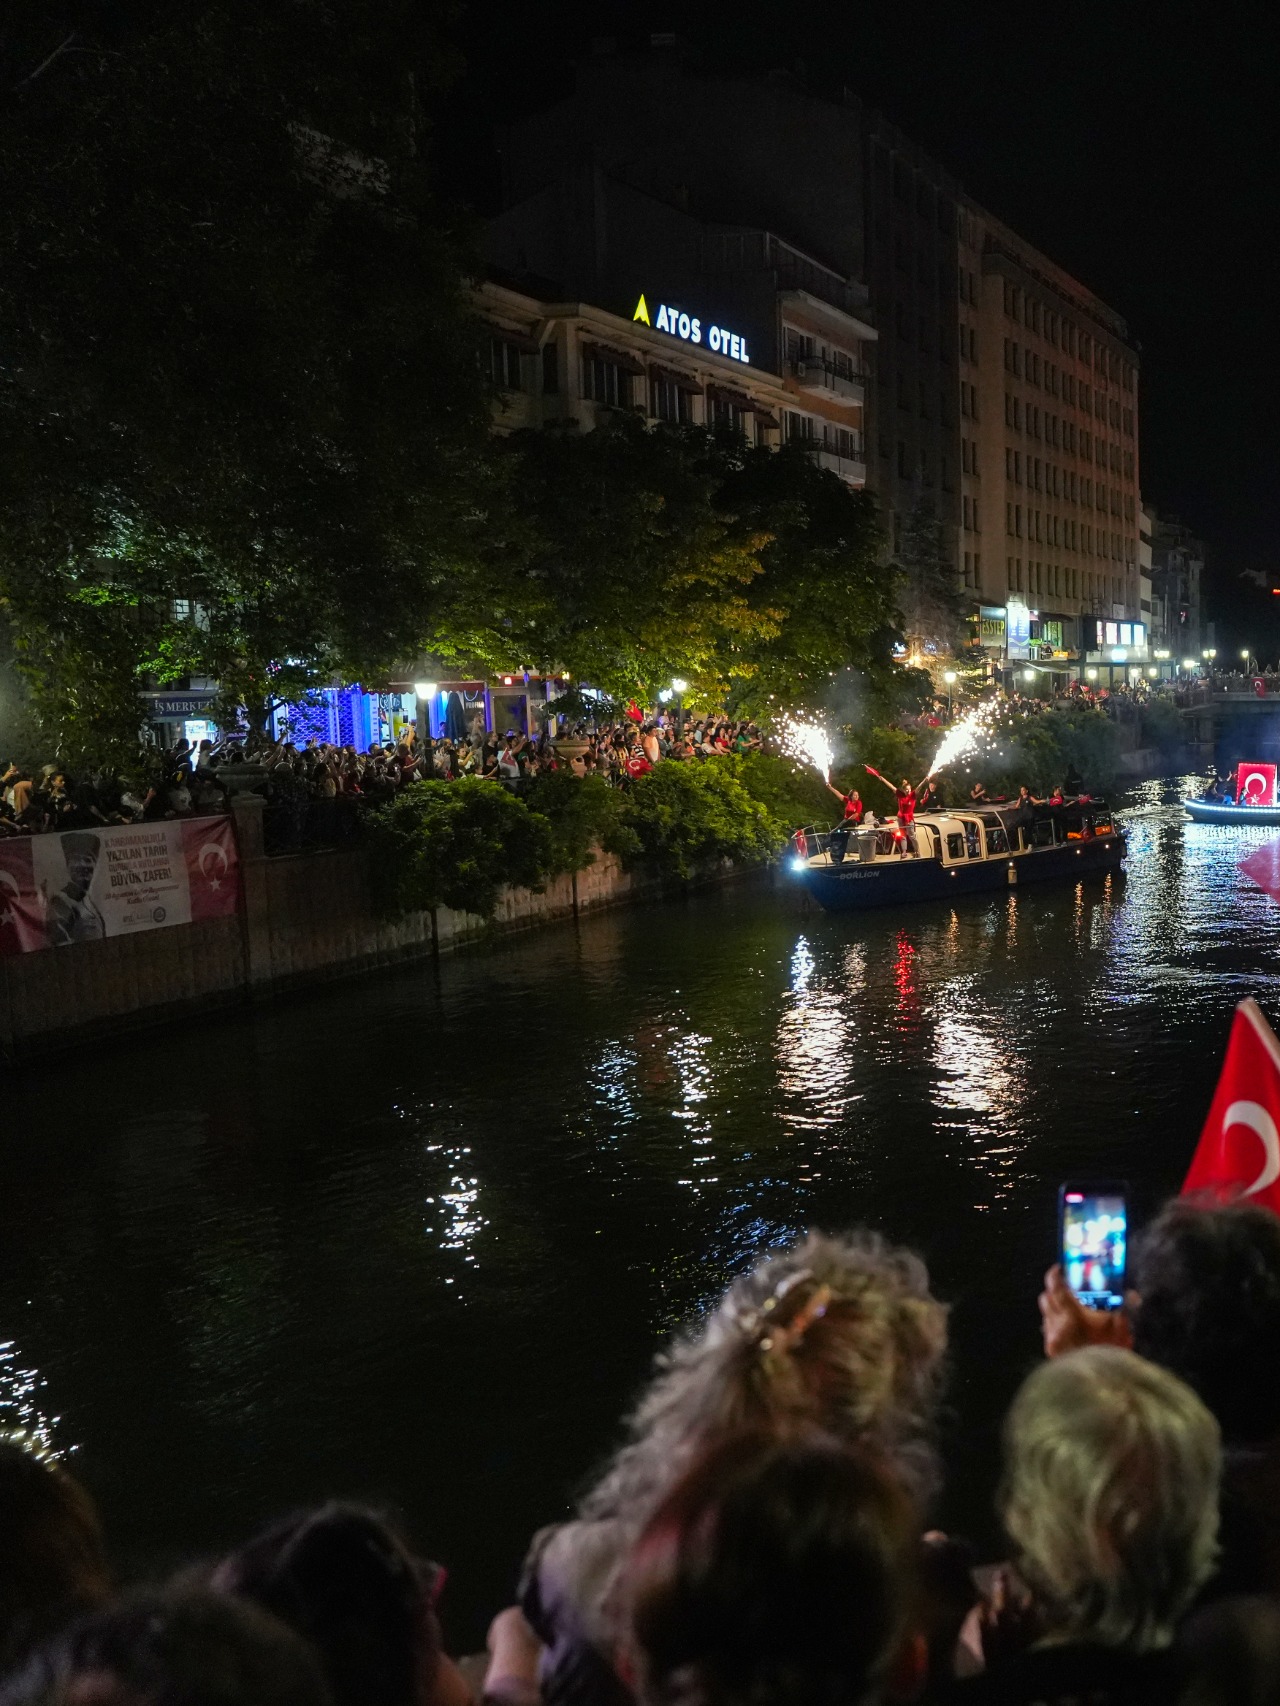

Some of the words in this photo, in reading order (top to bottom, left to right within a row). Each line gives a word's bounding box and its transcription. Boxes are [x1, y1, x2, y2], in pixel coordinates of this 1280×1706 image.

[656, 304, 702, 343] ATOS
[709, 326, 750, 363] OTEL
[106, 848, 142, 861] YAZILAN
[111, 870, 142, 887] BÜYÜK
[143, 868, 172, 882] ZAFER!
